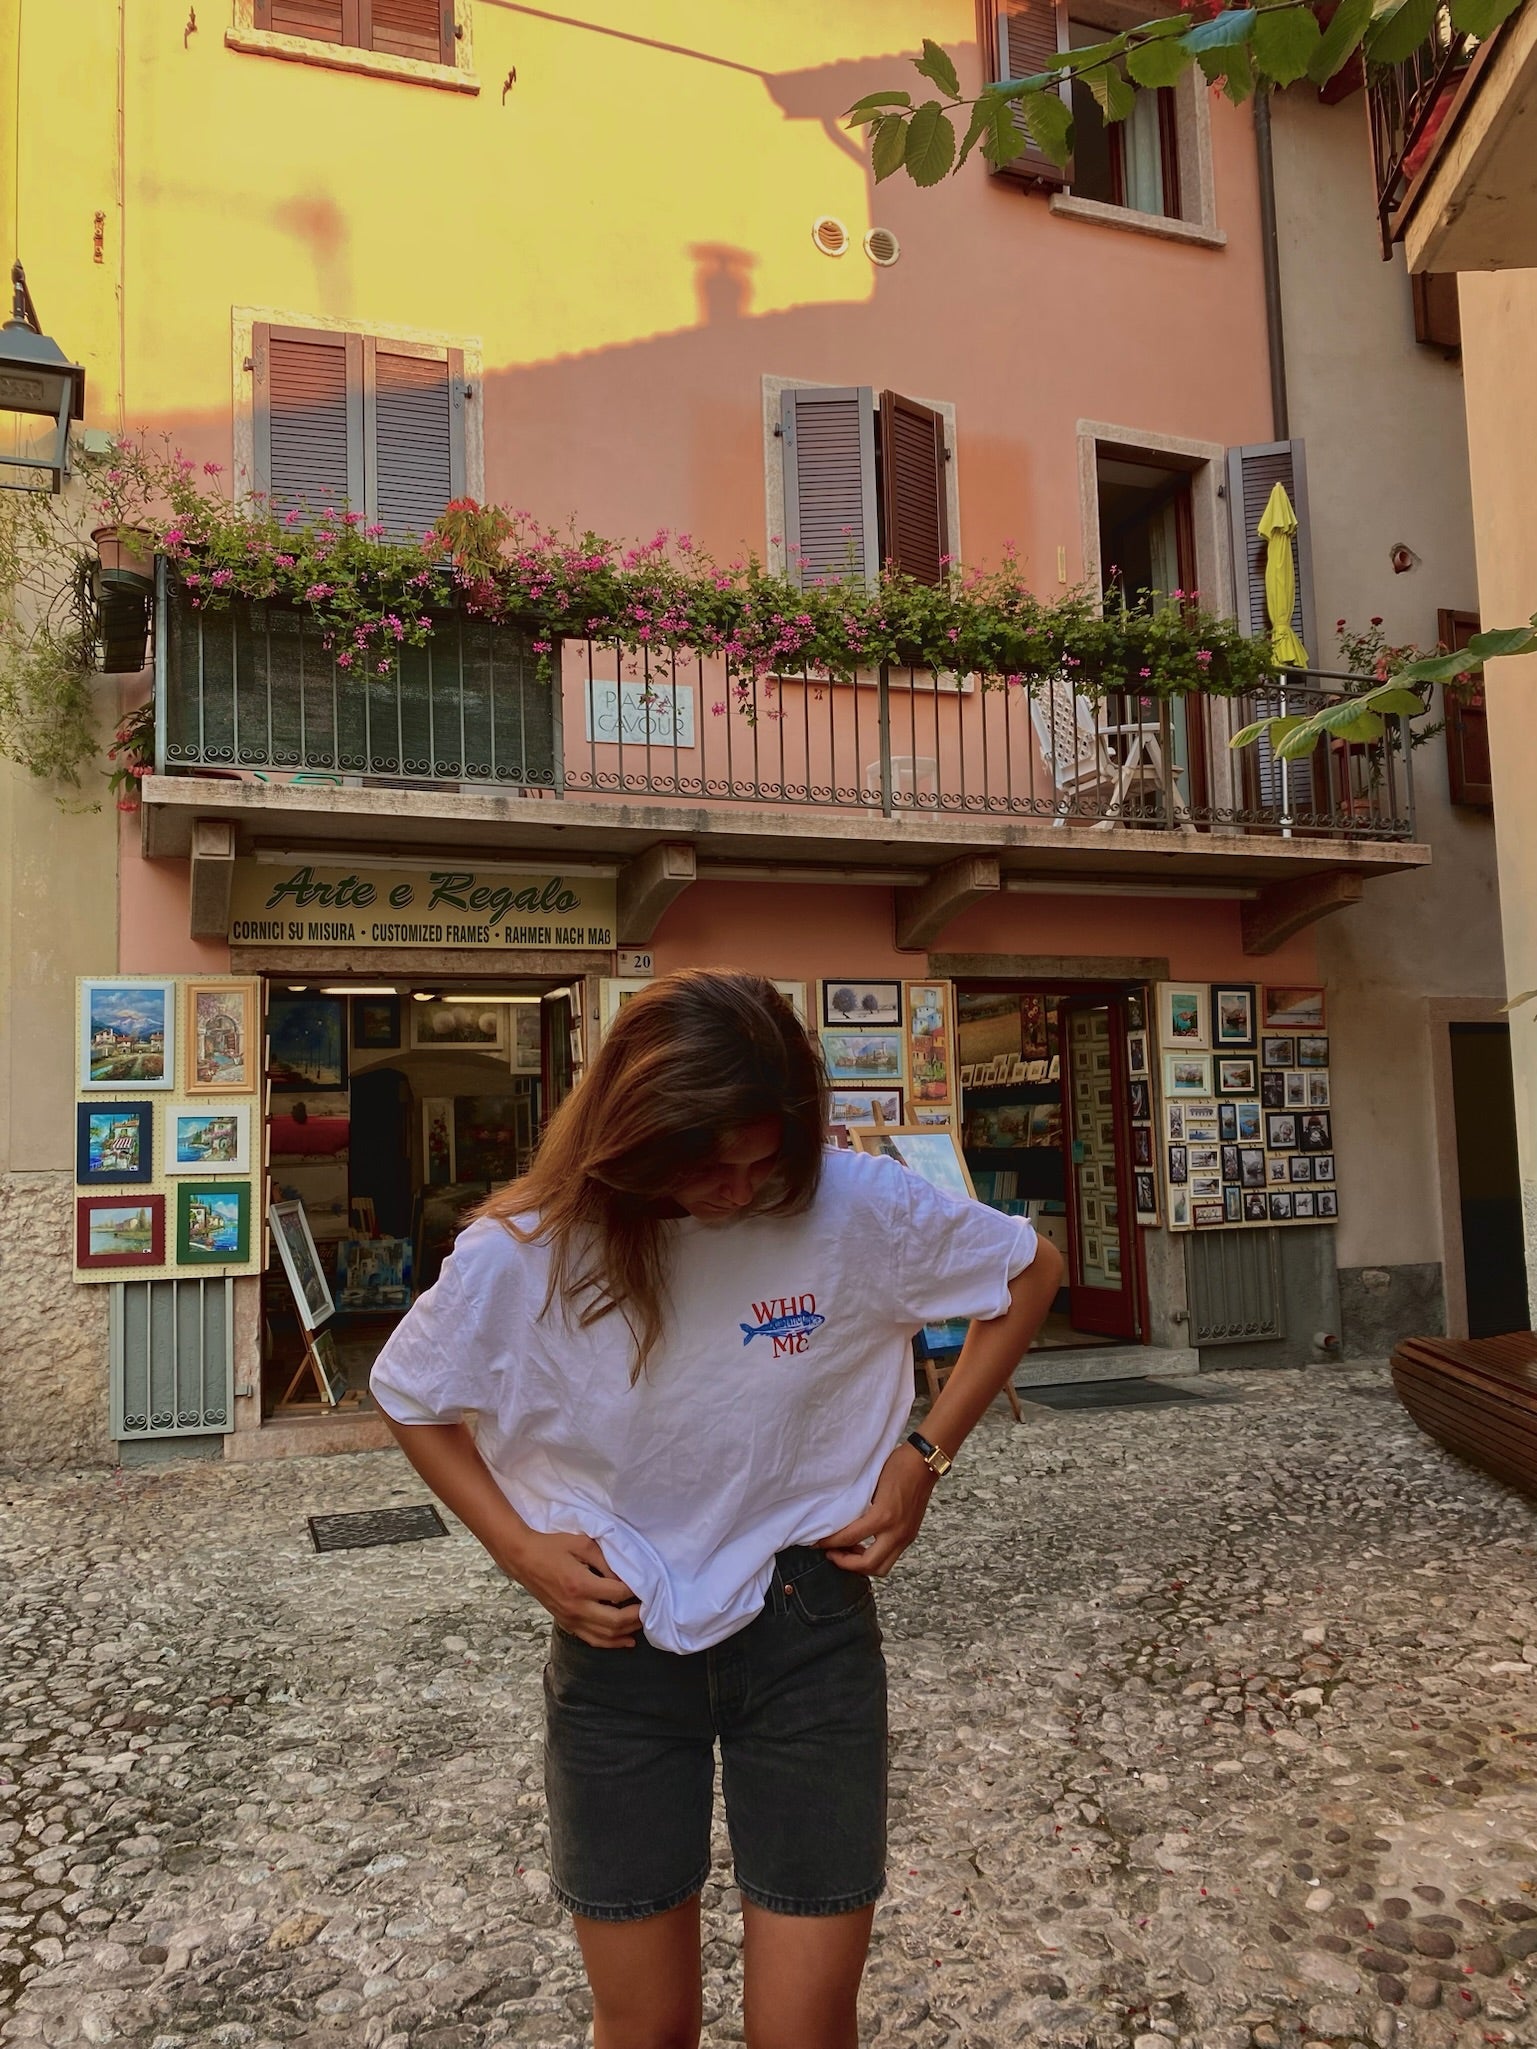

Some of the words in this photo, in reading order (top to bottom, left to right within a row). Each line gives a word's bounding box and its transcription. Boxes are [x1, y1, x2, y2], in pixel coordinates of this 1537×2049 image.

[605, 690, 675, 712] PAZZA
[598, 714, 685, 737] CAVOUR
[265, 866, 377, 910] Arte
[388, 883, 414, 910] e
[428, 871, 581, 927] Regalo
[233, 920, 284, 940] CORNICI
[288, 921, 304, 941] SU
[308, 922, 356, 942] MISURA
[372, 923, 442, 943] CUSTOMIZED
[446, 925, 490, 943] FRAMES
[505, 926, 551, 944] RAHMEN
[634, 955, 651, 969] 20
